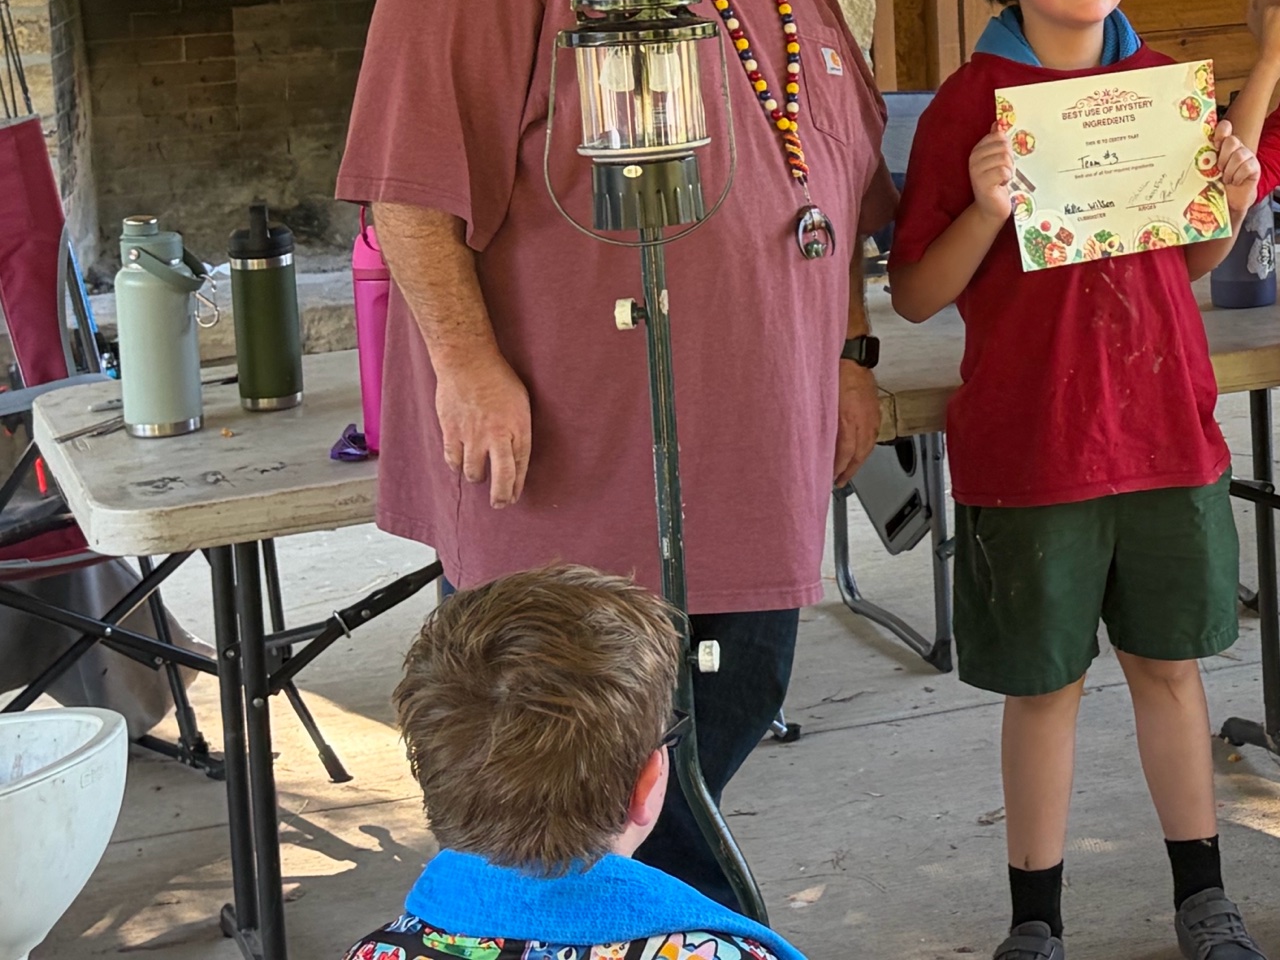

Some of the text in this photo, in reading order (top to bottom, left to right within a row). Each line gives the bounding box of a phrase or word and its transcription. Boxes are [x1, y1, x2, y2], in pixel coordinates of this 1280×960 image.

[1062, 100, 1153, 120] BEST USE OF MYSTERY
[1082, 114, 1136, 128] INGREDIENTS
[1078, 155, 1101, 169] Team
